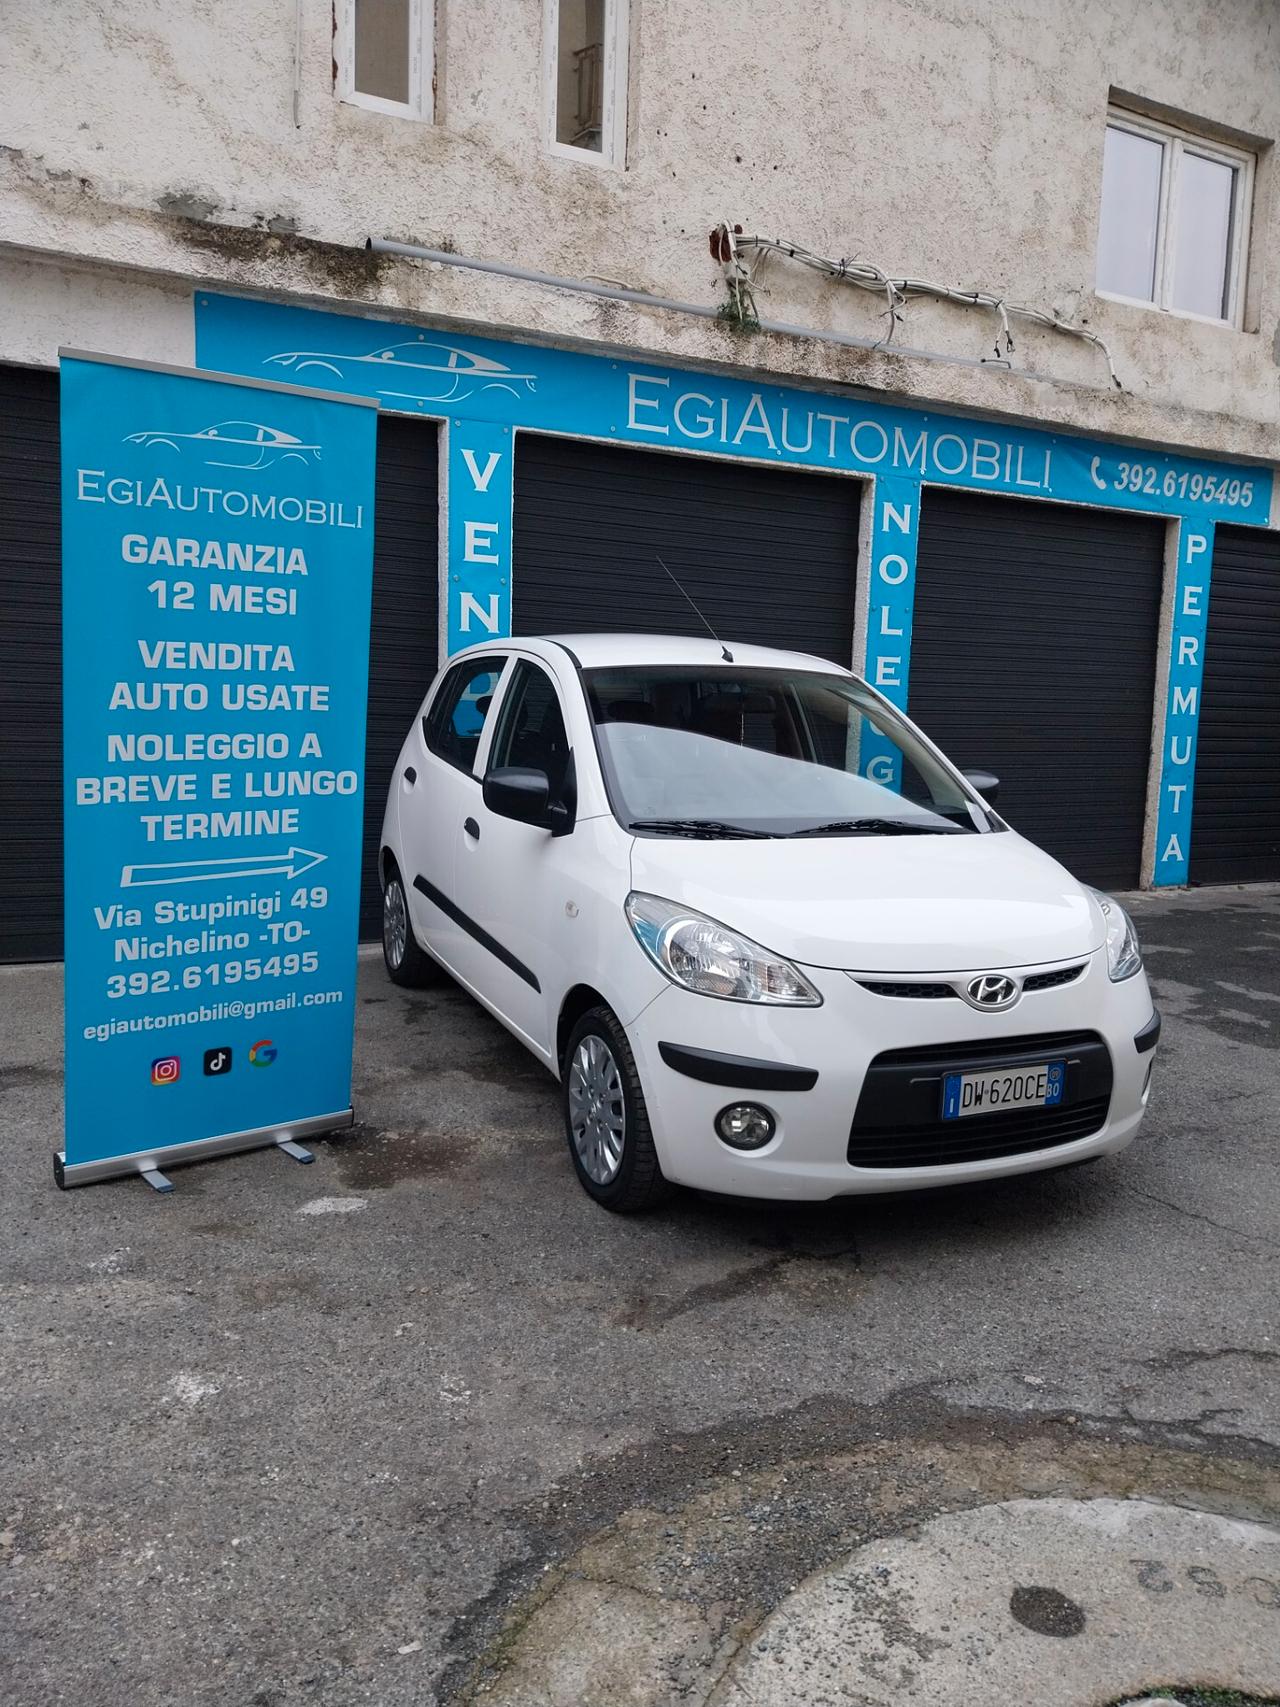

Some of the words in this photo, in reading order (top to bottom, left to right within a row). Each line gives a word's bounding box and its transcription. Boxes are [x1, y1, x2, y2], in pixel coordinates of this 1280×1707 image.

[1114, 462, 1254, 508] 392.6195495
[121, 533, 308, 576] GARANZIA
[147, 579, 195, 610] 12
[209, 583, 297, 616] MESI
[137, 639, 295, 672] VENDITA
[866, 501, 912, 785] NOLEG
[109, 681, 209, 711] AUTO
[222, 684, 330, 711] USATE
[1161, 534, 1207, 863] PERMUTA
[107, 733, 289, 762] NOLEGGIO
[299, 732, 323, 759] A
[76, 774, 197, 805] BREVE
[211, 773, 232, 799] E
[245, 770, 359, 798] LUNGO
[140, 808, 300, 842] TERMINE
[94, 904, 142, 930] Via
[154, 891, 281, 925] Stupinigi
[290, 886, 329, 909] 49
[114, 930, 249, 962] Nichelino
[259, 920, 311, 944] -TO-
[106, 951, 320, 999] 392.6195495
[83, 988, 344, 1043] egiautomobili@gmail.com
